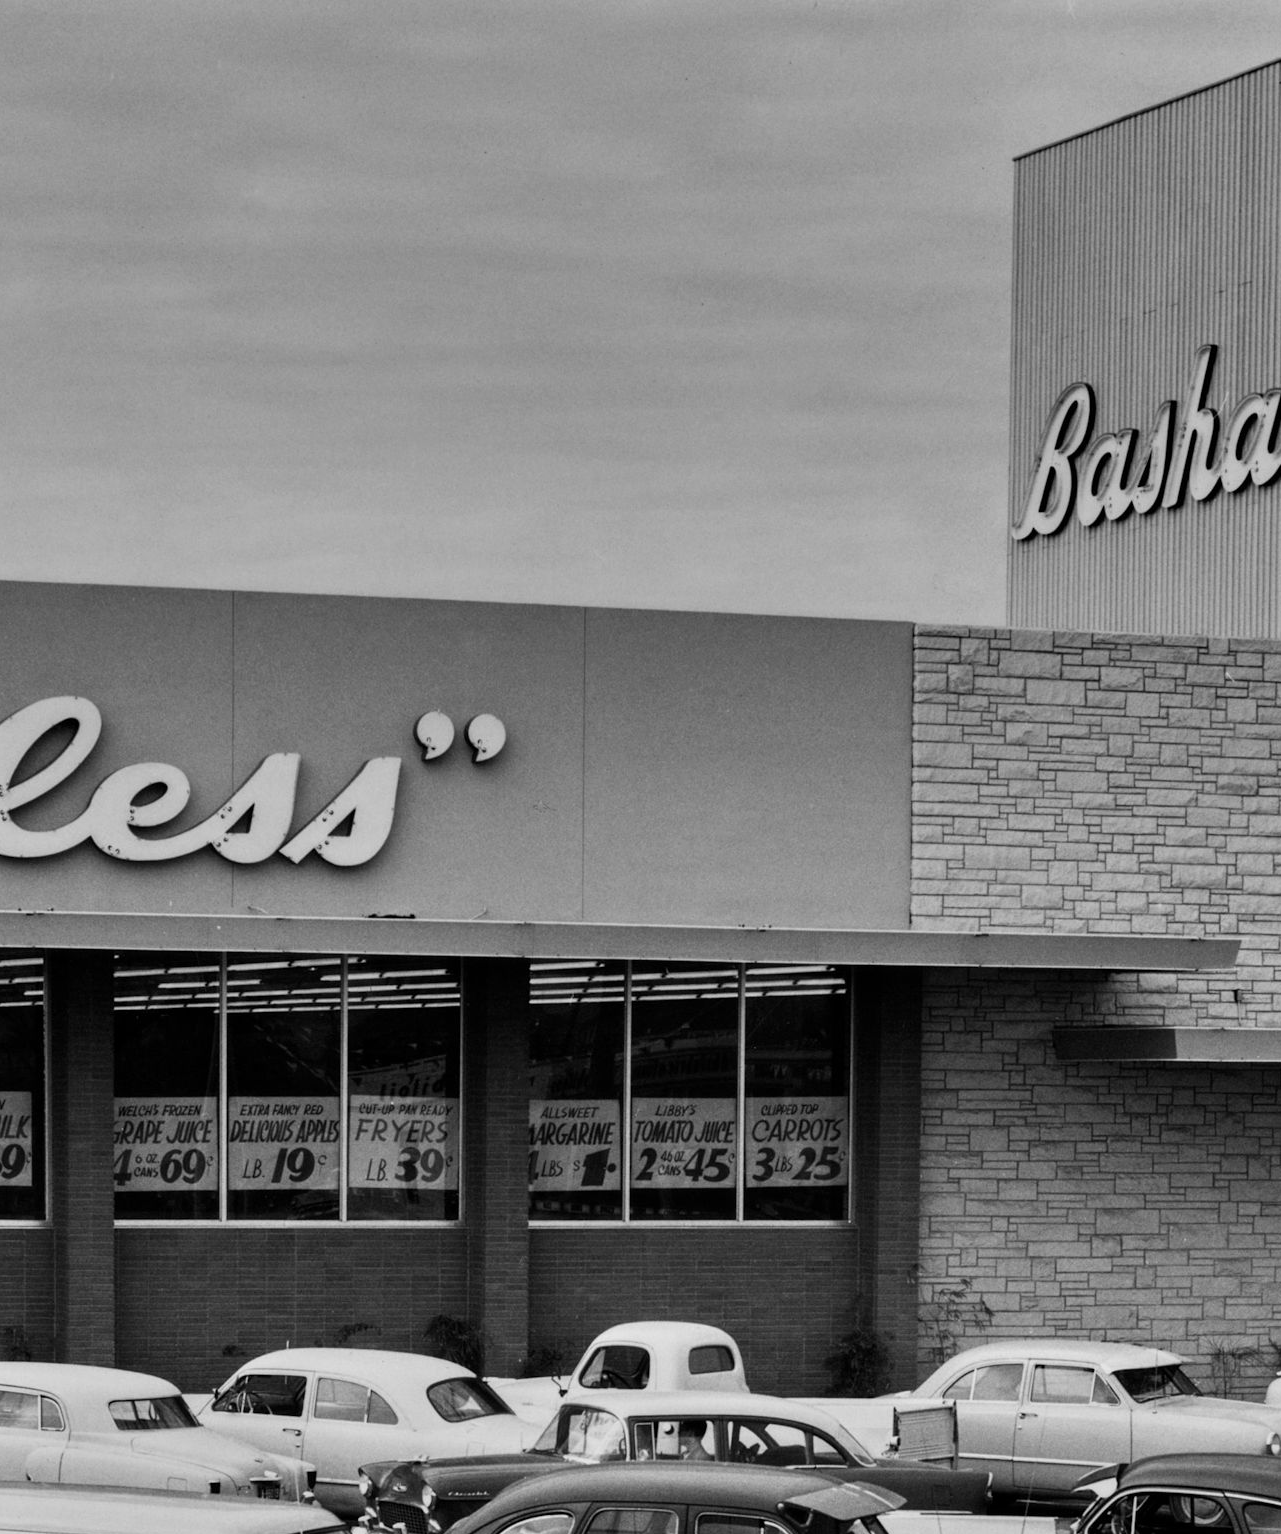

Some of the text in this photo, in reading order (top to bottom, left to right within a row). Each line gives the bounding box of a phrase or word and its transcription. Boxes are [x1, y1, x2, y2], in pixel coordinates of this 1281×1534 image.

[118, 1104, 202, 1117] WELCH'S FROZEN
[239, 1104, 324, 1117] EXTRA FANCY RED
[358, 1104, 453, 1117] CUT-UP PAN READY
[540, 1106, 600, 1119] ALLSWEET
[655, 1103, 697, 1117] LIBBY'S
[760, 1103, 820, 1116] CLIPPED TOP
[166, 1120, 212, 1144] JUICE
[229, 1119, 340, 1144] DELICIOUS APPLES
[355, 1119, 449, 1144] FRYERS
[634, 1119, 735, 1144] TOMATO JUICE
[751, 1118, 844, 1144] CARROTS
[135, 1154, 159, 1164] 6 OZ.
[639, 1147, 657, 1181] 2
[752, 1147, 776, 1182] 3
[775, 1156, 793, 1173] LBS
[134, 1166, 158, 1179] CANS
[242, 1159, 265, 1179] LB.
[366, 1158, 389, 1182] LB.
[541, 1160, 563, 1178] LBS
[658, 1165, 682, 1177] CANS
